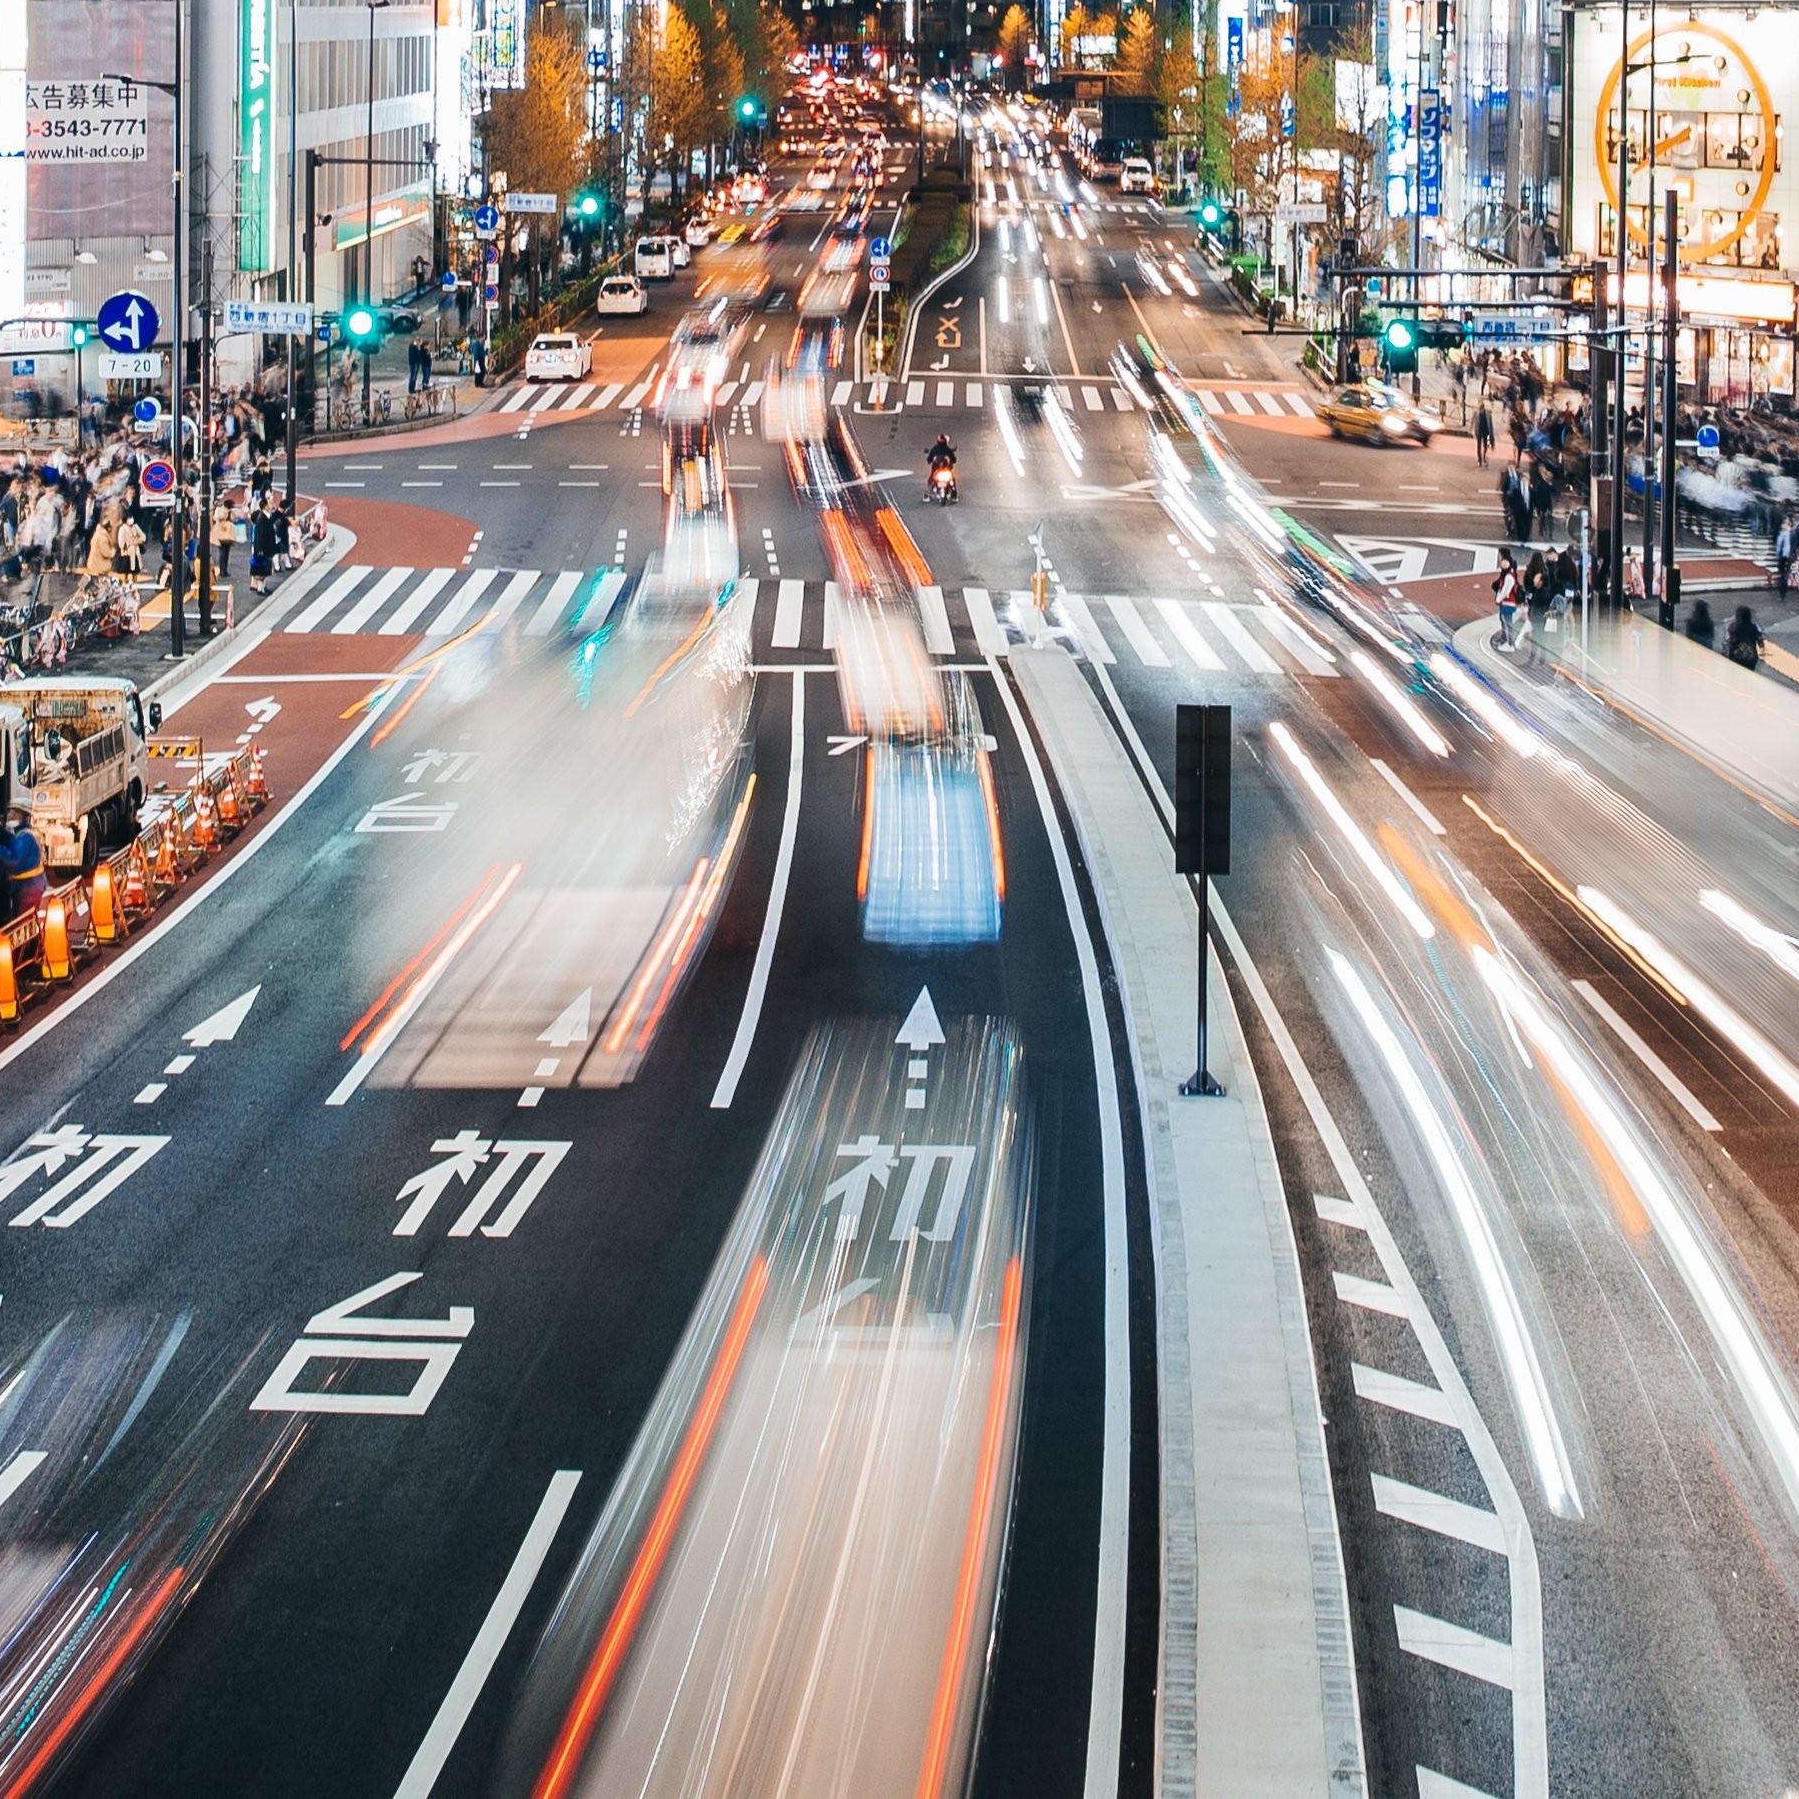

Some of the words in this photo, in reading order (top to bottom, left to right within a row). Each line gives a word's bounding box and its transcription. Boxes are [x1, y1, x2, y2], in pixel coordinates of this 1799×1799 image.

[229, 310, 307, 325] 西新宿1丁目
[1481, 321, 1551, 334] 西新宿一丁目
[108, 358, 152, 373] 7-20
